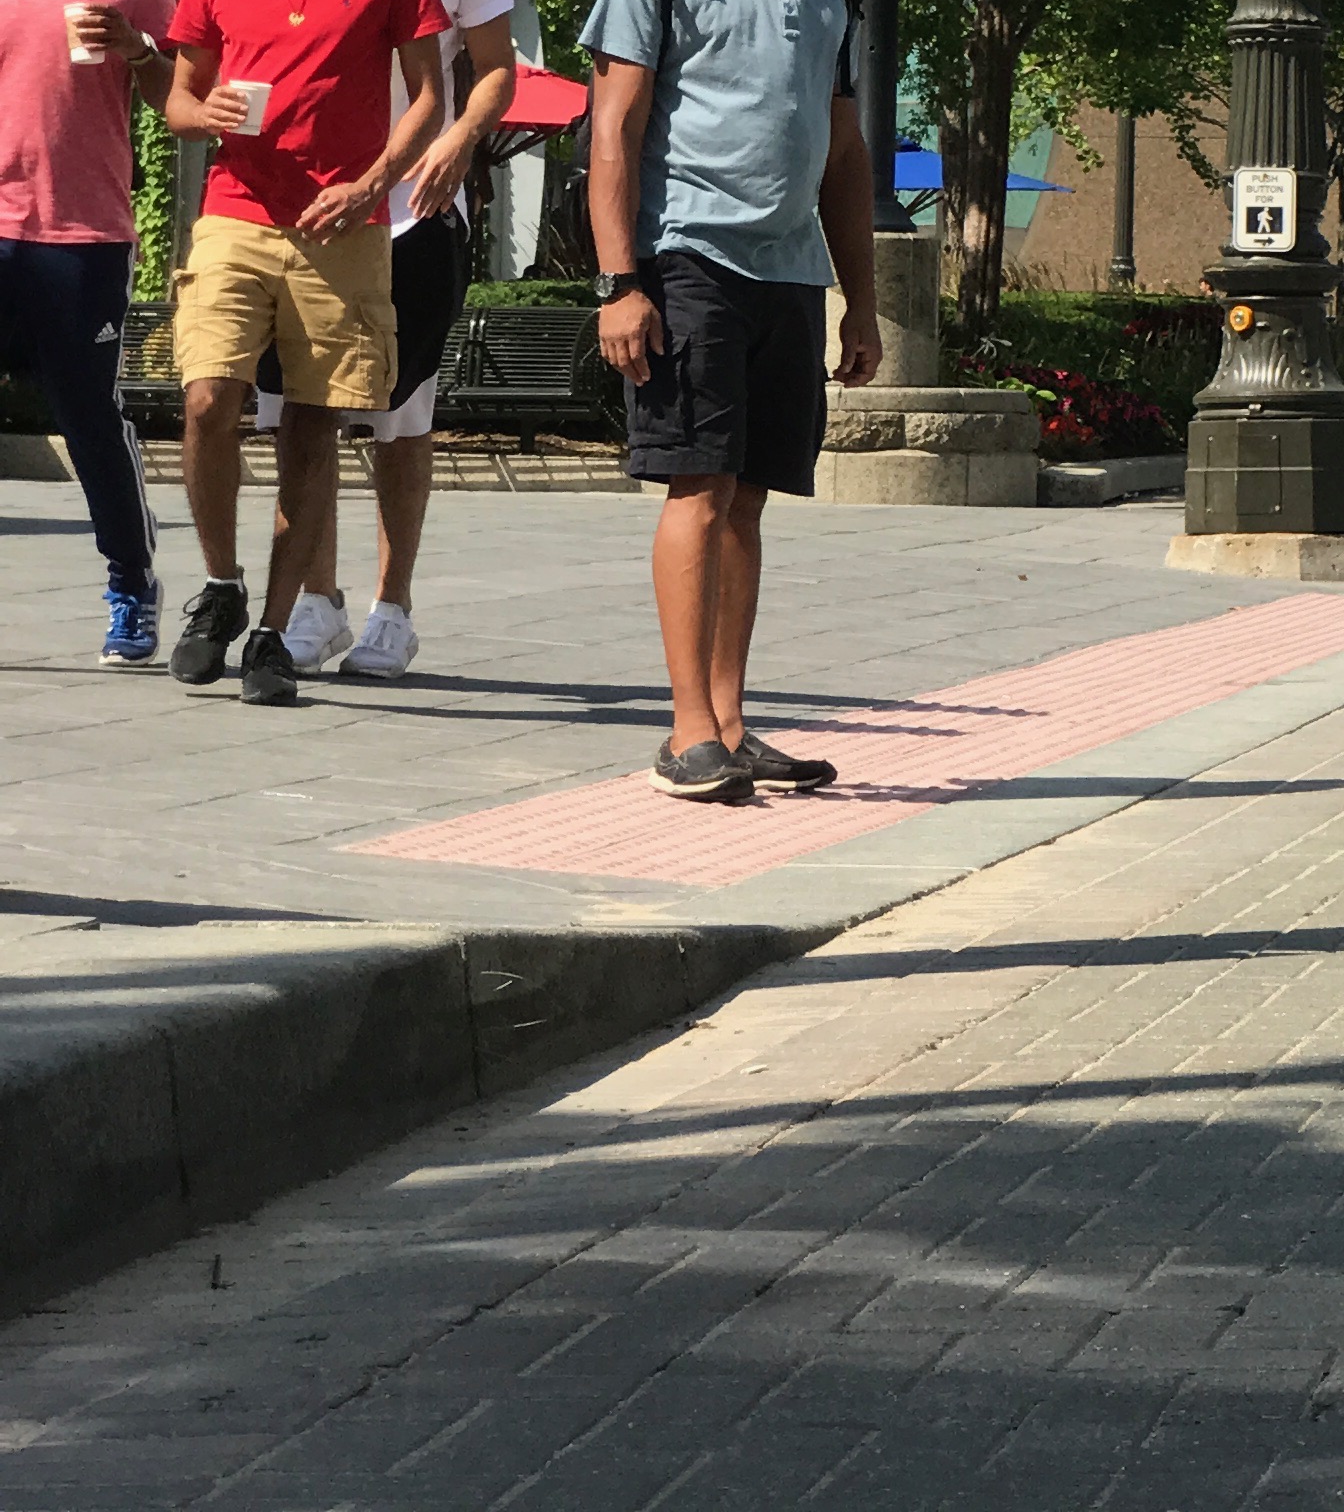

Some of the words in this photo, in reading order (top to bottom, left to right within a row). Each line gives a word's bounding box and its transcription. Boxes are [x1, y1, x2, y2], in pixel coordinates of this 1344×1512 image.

[1252, 174, 1278, 182] PUSH
[1246, 185, 1284, 193] BUTTON
[1255, 195, 1274, 203] FOR
